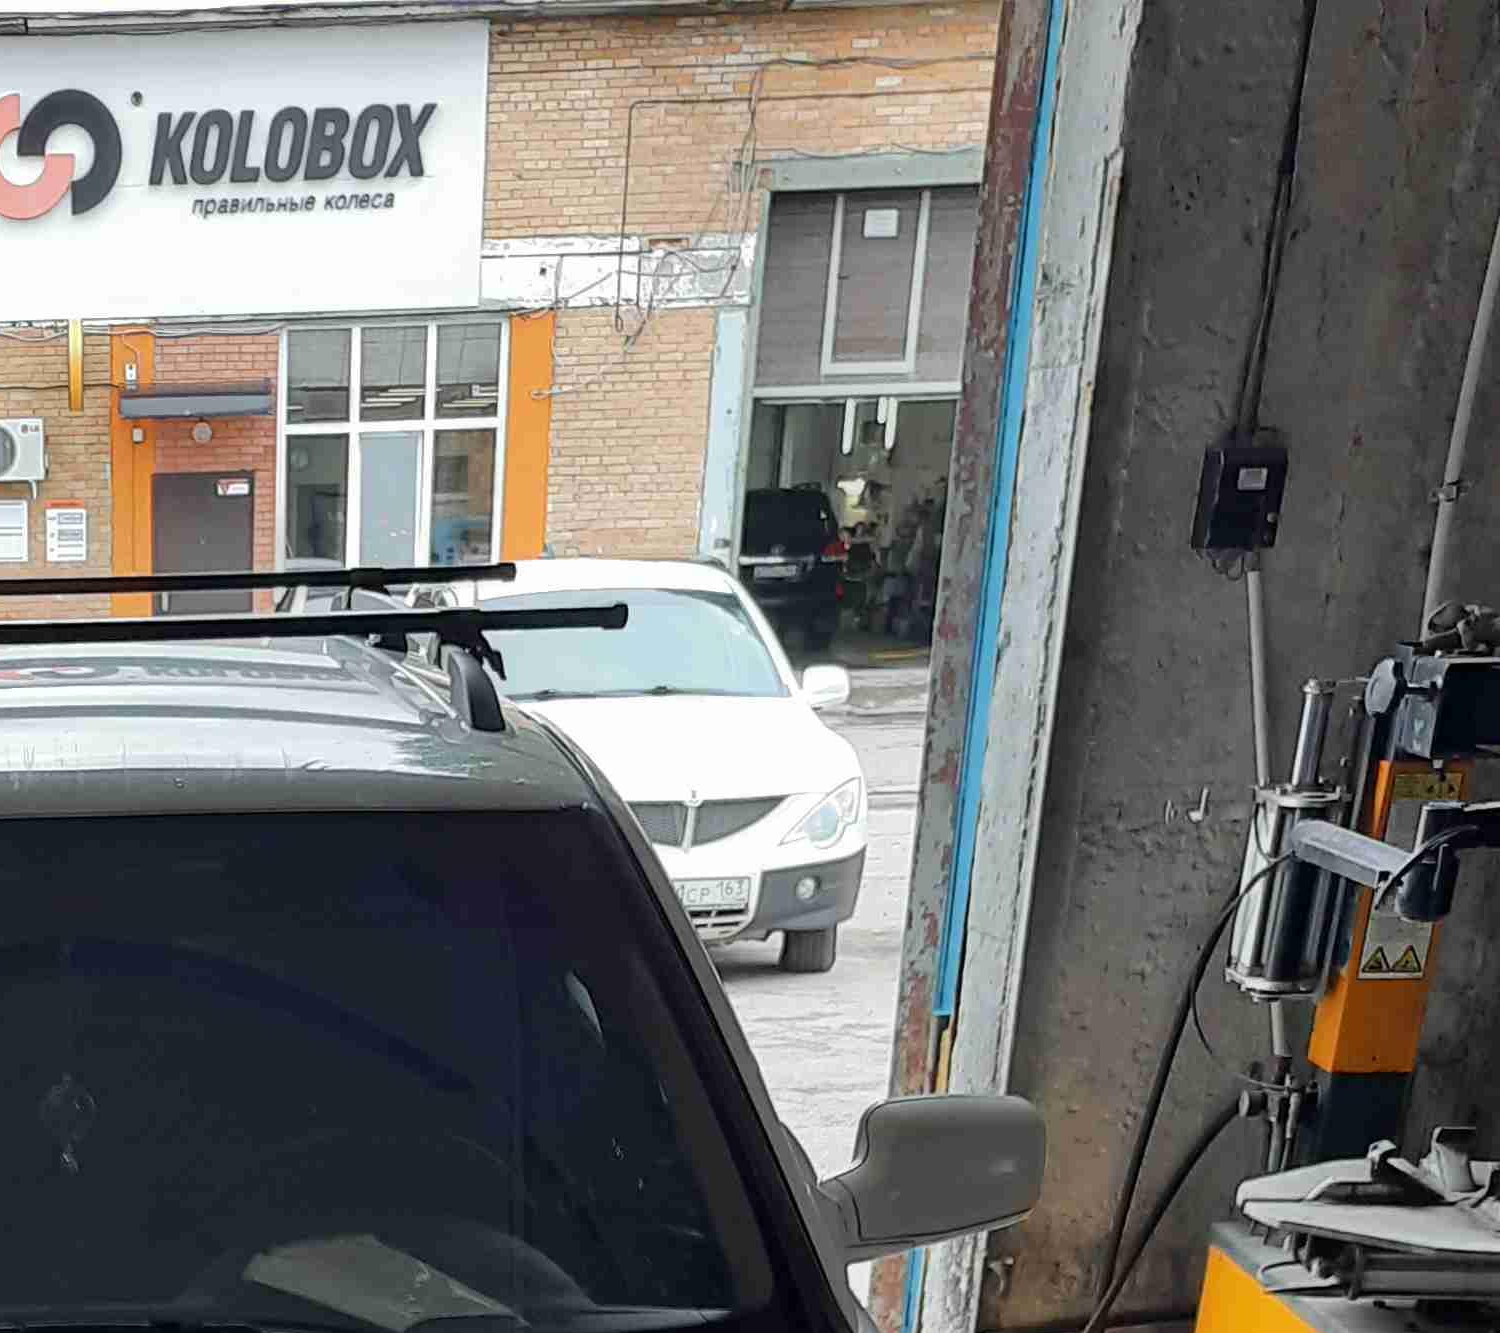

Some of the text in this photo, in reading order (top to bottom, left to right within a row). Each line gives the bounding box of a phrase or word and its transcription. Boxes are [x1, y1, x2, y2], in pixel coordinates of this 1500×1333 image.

[148, 102, 438, 187] KOLOBOX
[191, 190, 395, 219] правильные колеса
